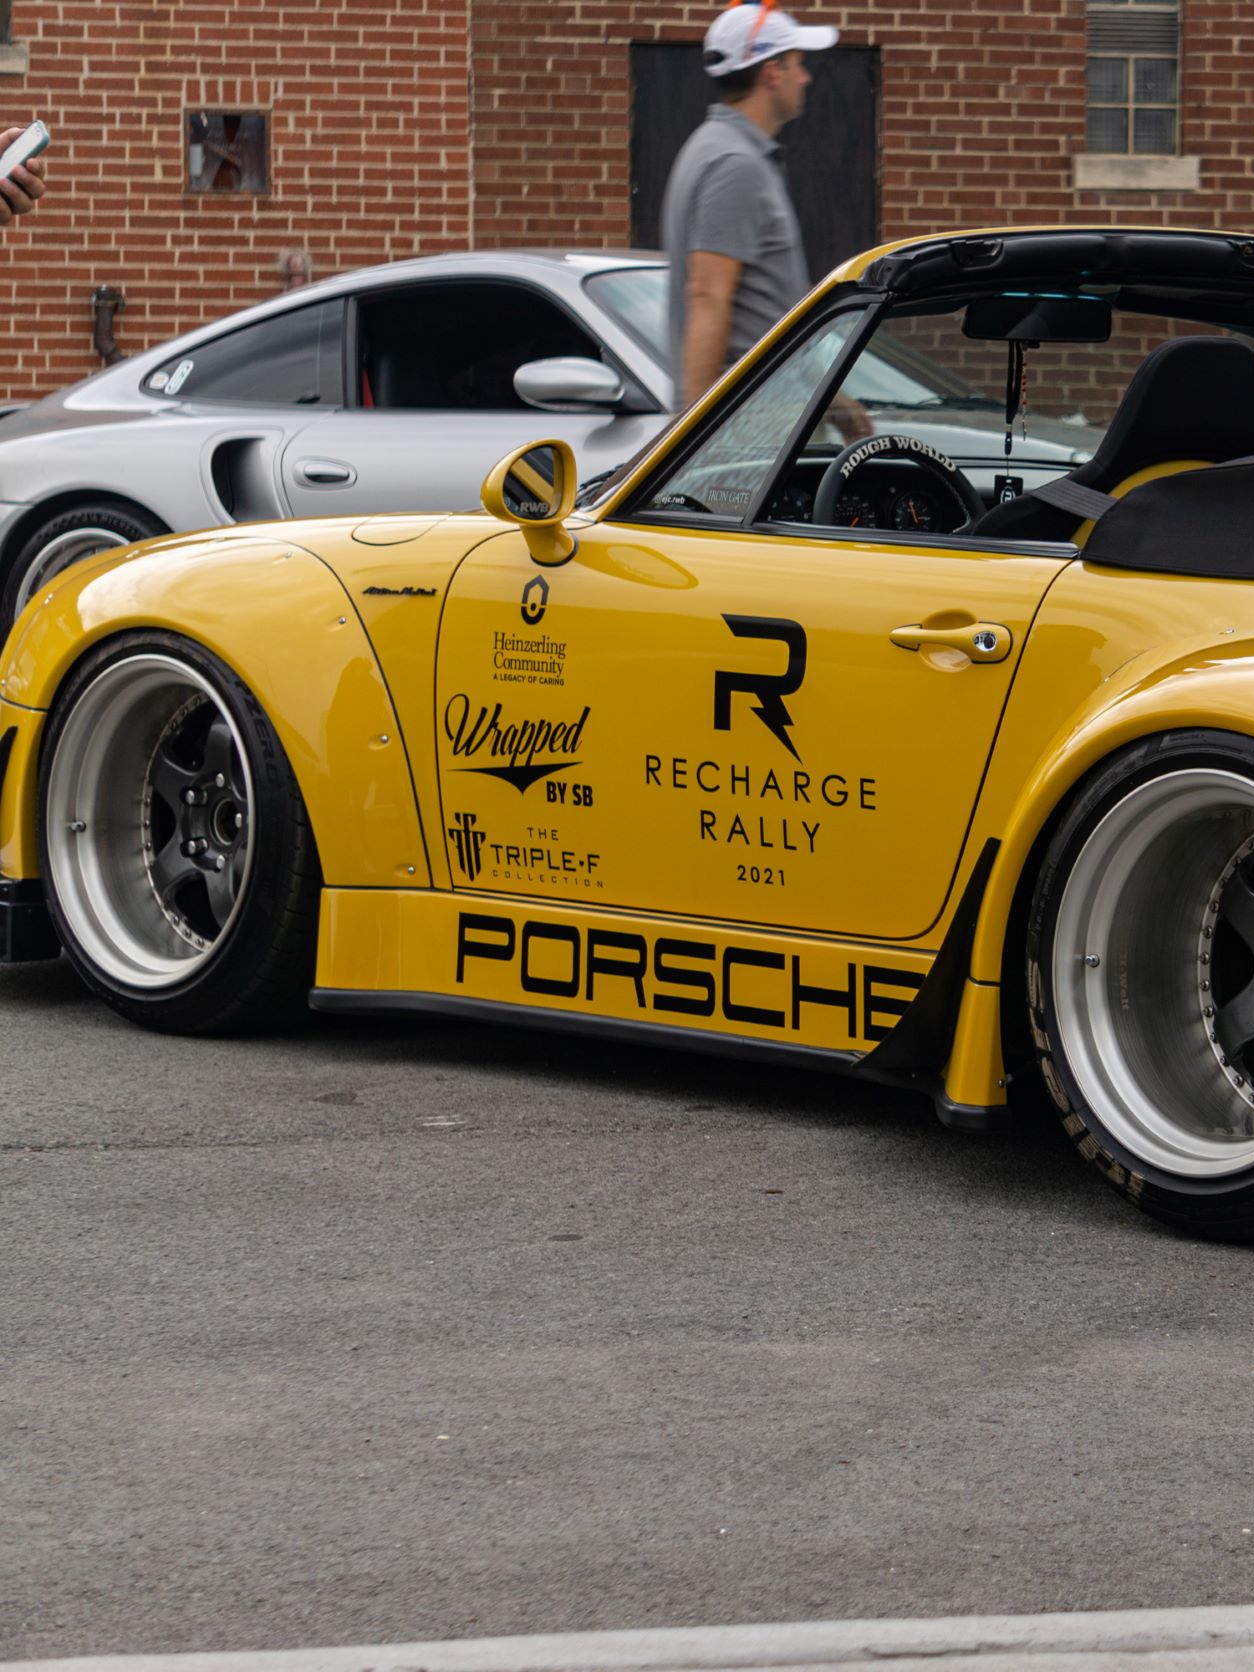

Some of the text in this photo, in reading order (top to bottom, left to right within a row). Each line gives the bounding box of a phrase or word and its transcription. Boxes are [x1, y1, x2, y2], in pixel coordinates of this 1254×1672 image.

[840, 436, 957, 479] ROUGH WORLD
[493, 631, 567, 660] Heinzerling
[493, 651, 564, 678] Community
[493, 673, 565, 687] A LEGACY OF CARING
[445, 693, 591, 766] Wrapped
[546, 781, 593, 807] BY SB
[646, 754, 877, 811] RECHARGE
[527, 827, 559, 841] THE
[700, 809, 820, 853] RALLY
[492, 869, 603, 889] COLLECTION
[737, 864, 786, 887] 2021
[456, 911, 927, 1042] PORSCHE
